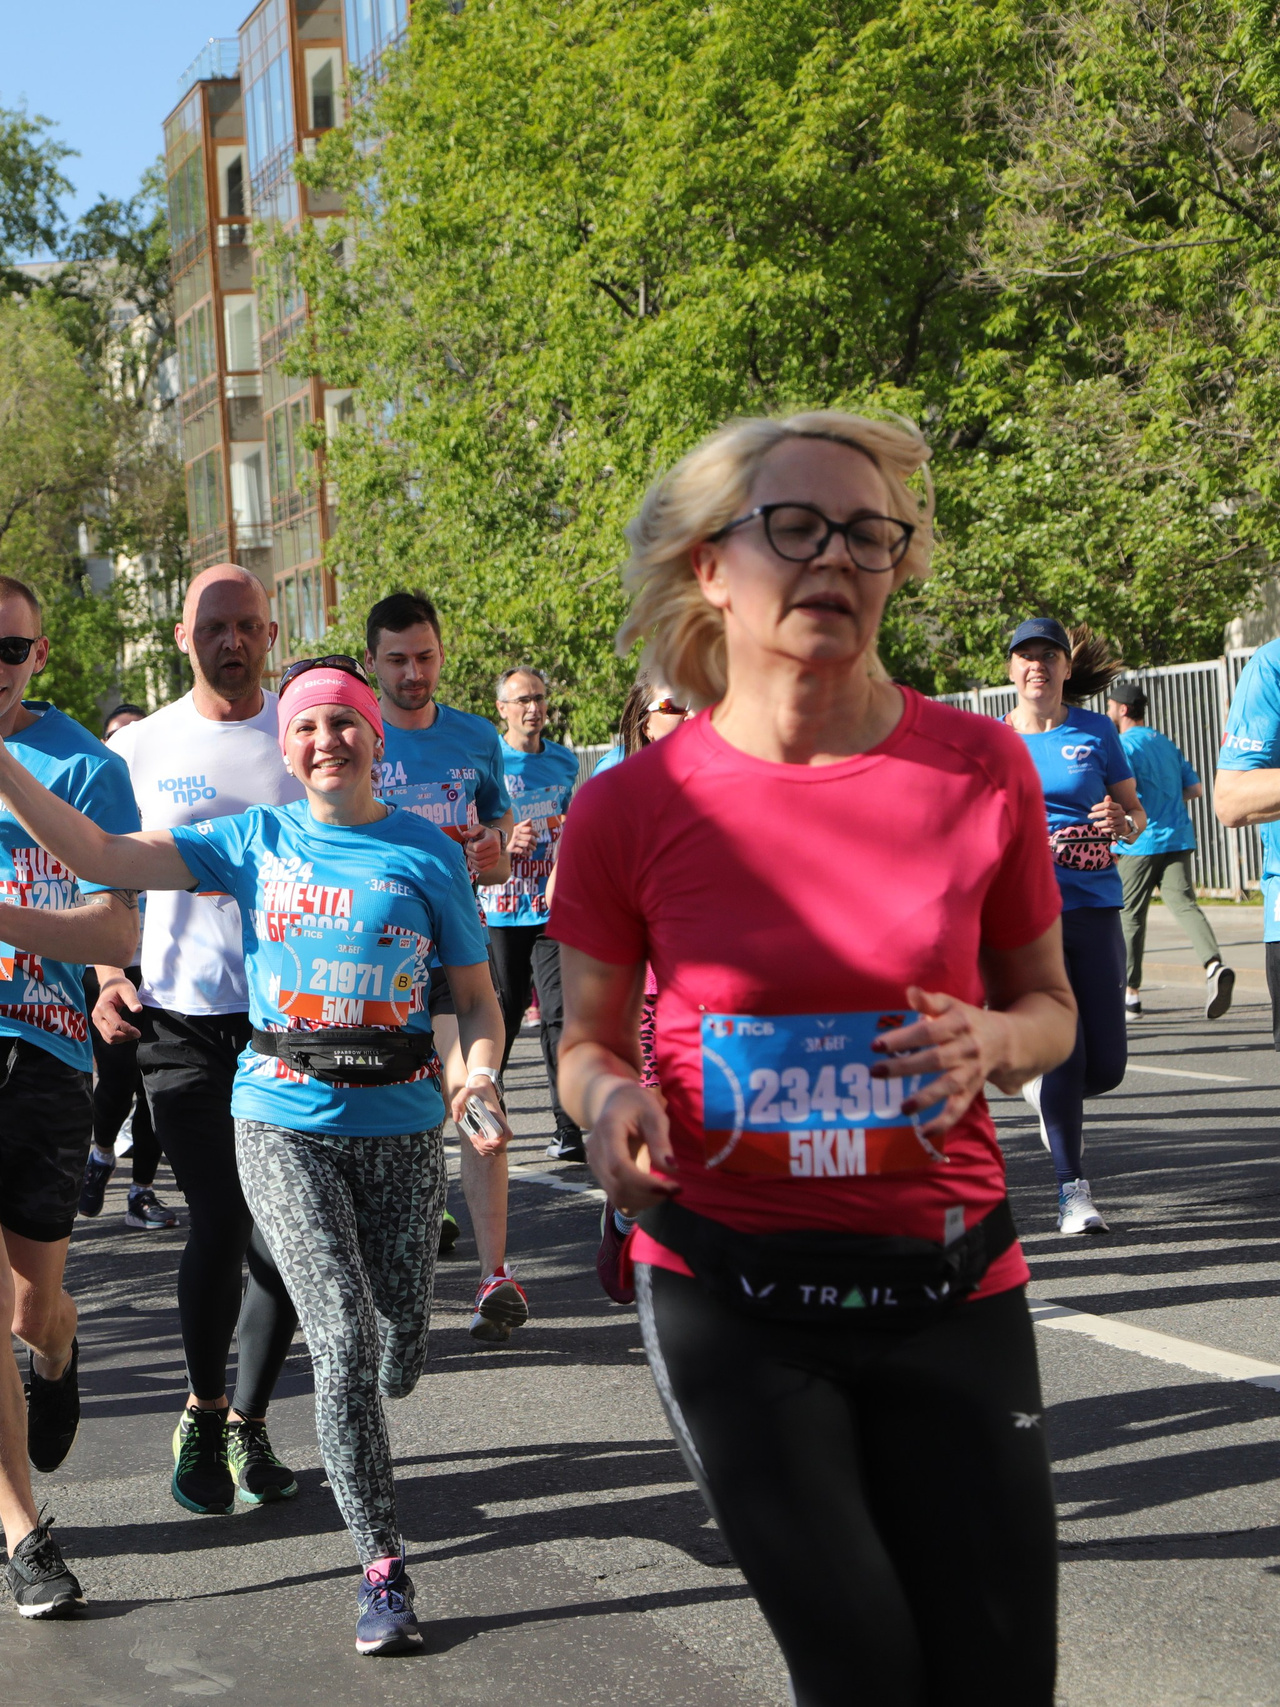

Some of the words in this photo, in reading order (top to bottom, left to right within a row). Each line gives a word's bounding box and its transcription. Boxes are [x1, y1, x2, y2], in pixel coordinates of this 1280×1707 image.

[402, 802, 452, 825] 991
[258, 850, 315, 882] 2024
[263, 881, 354, 918] #МЕЧТА
[303, 931, 324, 939] ПСБ
[309, 957, 384, 997] 21971
[398, 975, 408, 988] B
[321, 996, 365, 1026] 5KM
[737, 1022, 775, 1037] ПСБ
[788, 1127, 867, 1178] 5KM
